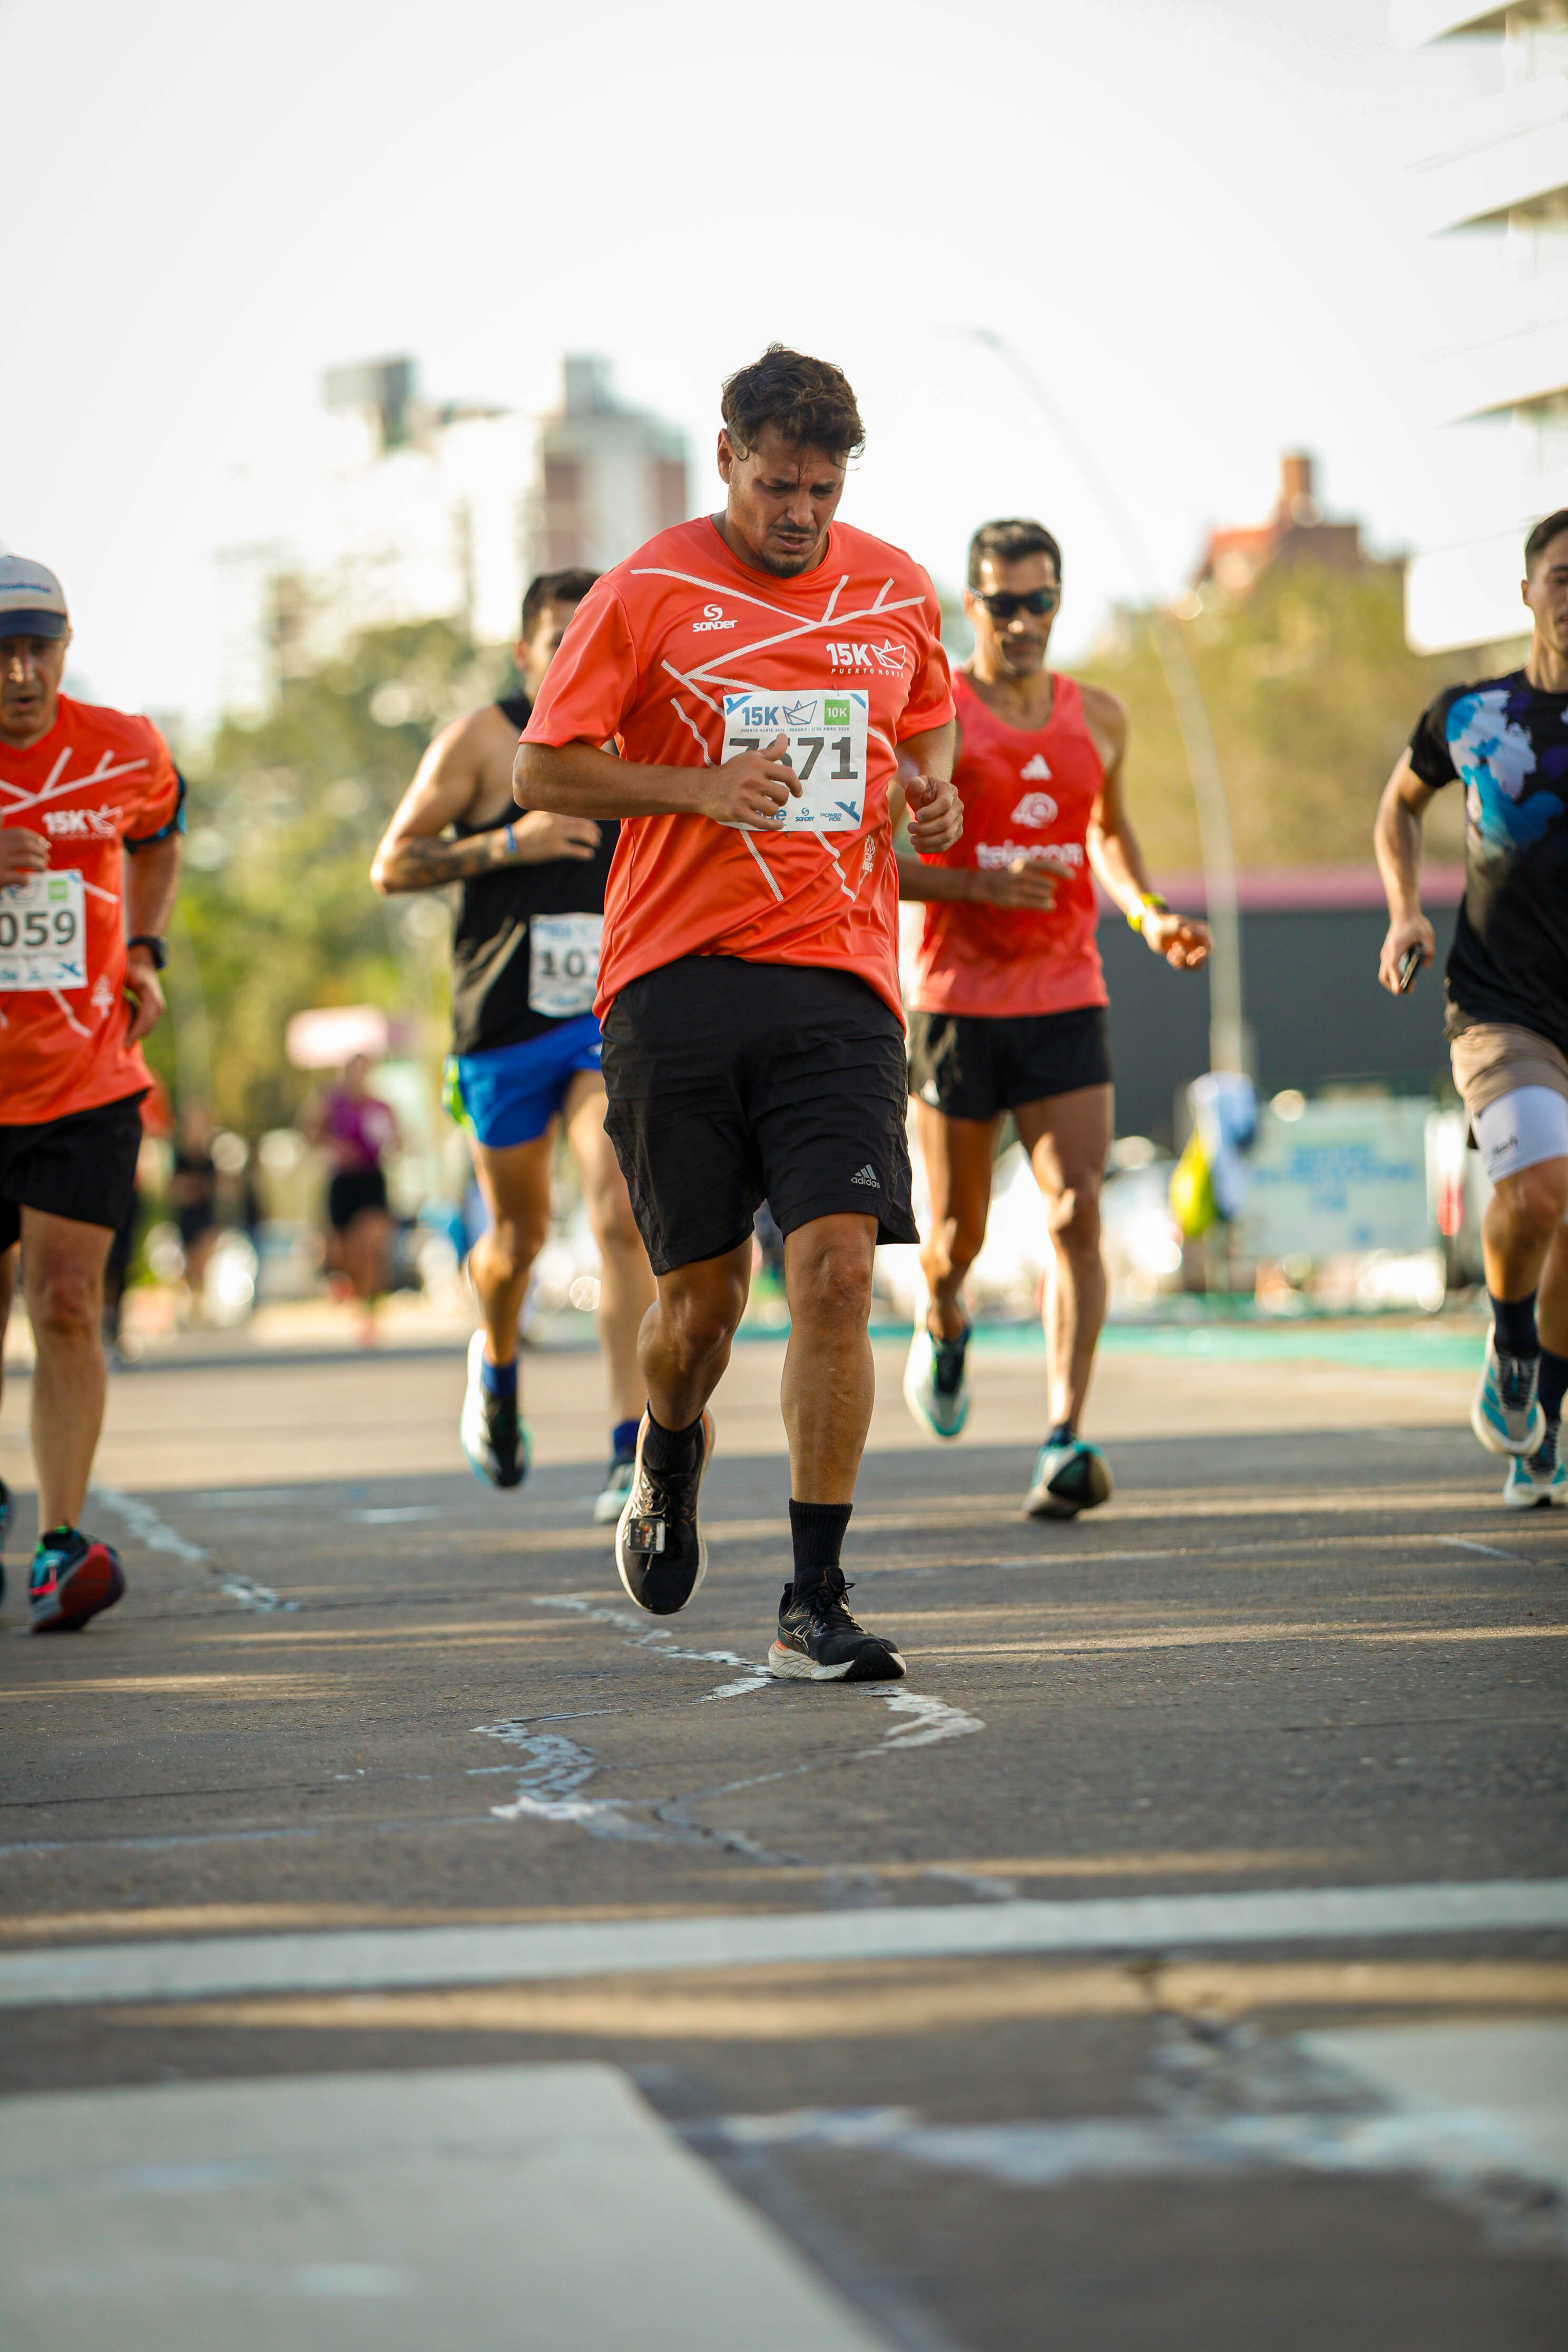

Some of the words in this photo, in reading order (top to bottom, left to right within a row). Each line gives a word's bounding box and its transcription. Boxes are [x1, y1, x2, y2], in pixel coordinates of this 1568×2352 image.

[826, 643, 873, 666] 15K
[878, 669, 904, 679] NORTE
[741, 706, 779, 726] 15K
[827, 708, 847, 718] 10K
[43, 810, 89, 834] 15K
[851, 1177, 880, 1189] adidas
